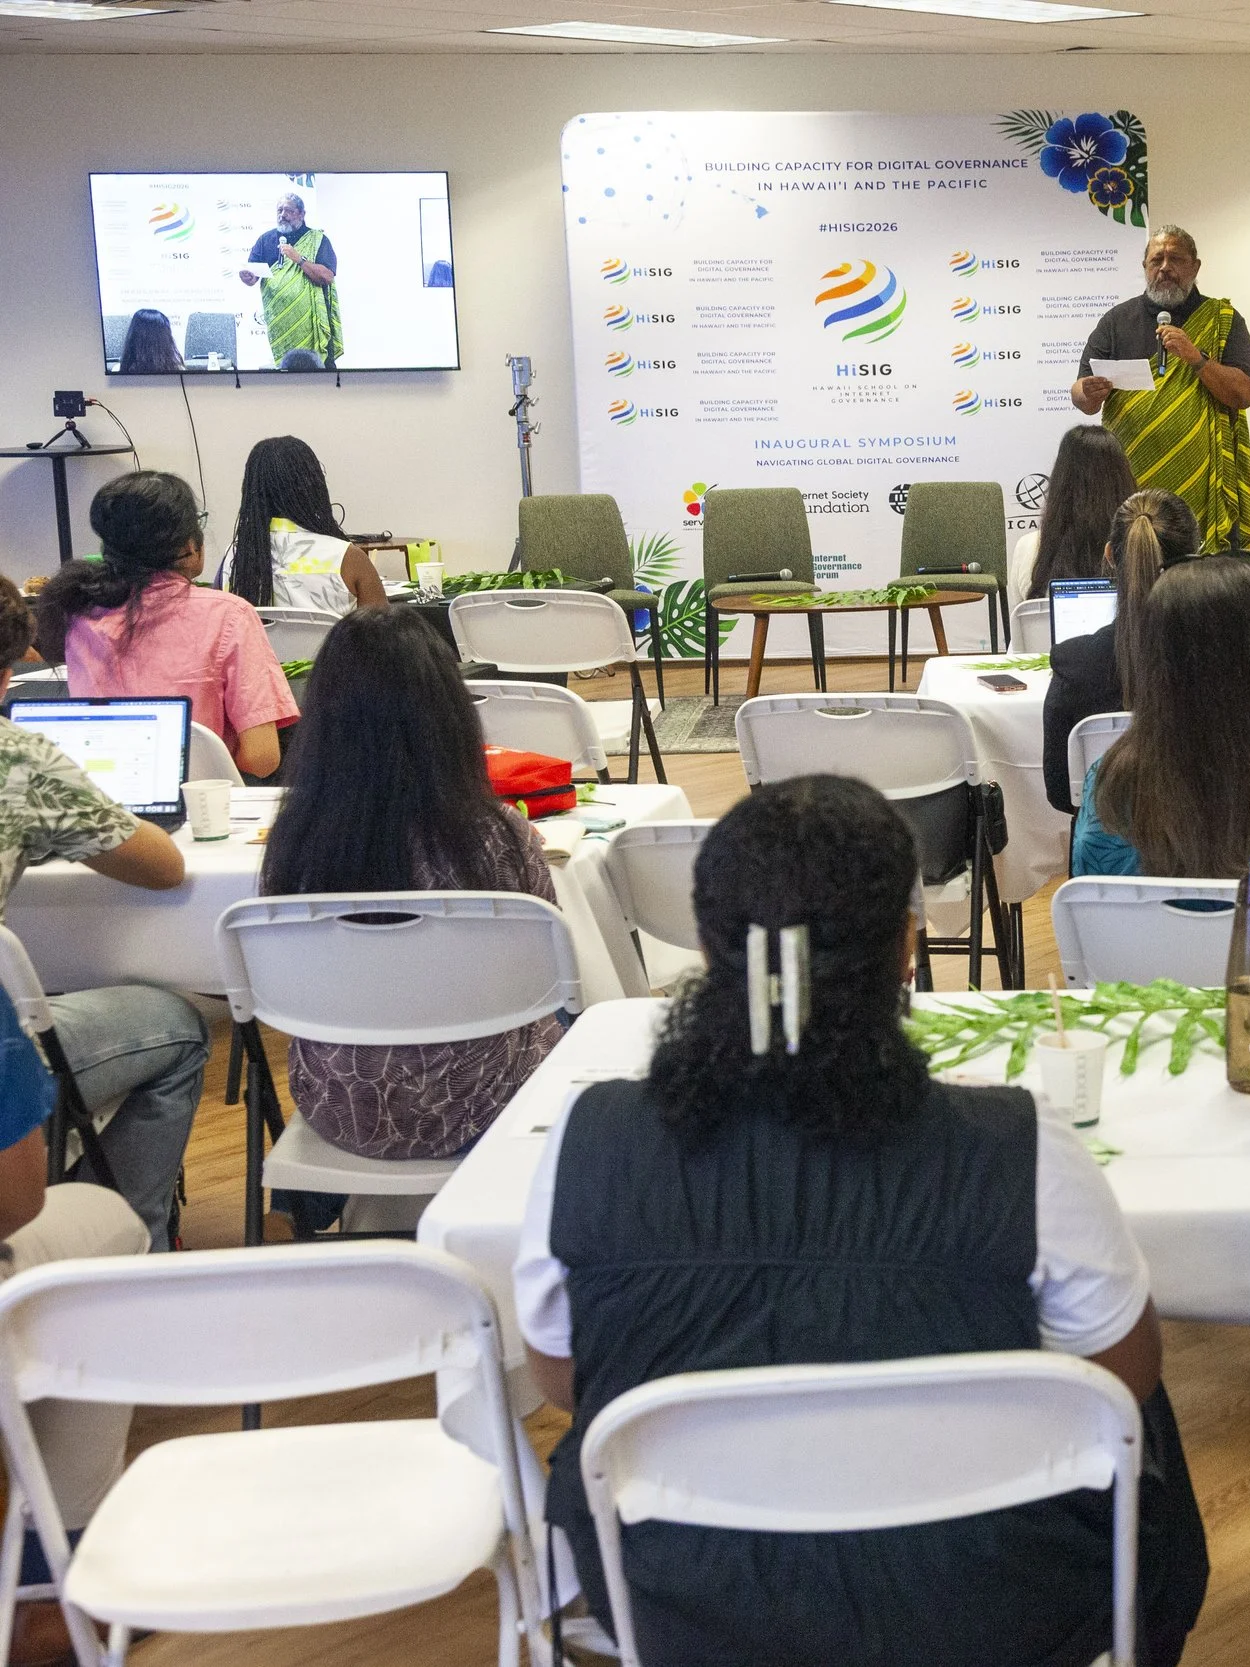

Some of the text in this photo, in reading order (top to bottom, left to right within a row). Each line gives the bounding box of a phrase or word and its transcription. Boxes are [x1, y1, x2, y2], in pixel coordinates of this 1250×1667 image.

[705, 158, 1029, 172] BUILDING CAPACITY FOR DIGITAL GOVERNANCE
[758, 179, 988, 192] IN HAWAII'I AND THE PACIFIC
[819, 222, 898, 233] #HISIG2026
[981, 260, 1020, 268] HiSIG
[633, 268, 672, 276] HiSIG
[983, 306, 1021, 314] HiSIG
[636, 314, 675, 323] HiSIG
[983, 351, 1021, 360] HiSIG
[637, 361, 676, 369] HiSIG
[836, 364, 892, 376] HiSIG
[984, 398, 1022, 407] HiSIG
[640, 408, 679, 417] HiSIG
[755, 436, 957, 449] INAUGURAL SYMPOSIUM
[832, 491, 869, 500] Society
[804, 501, 870, 513] undation
[1008, 520, 1038, 529] ICA
